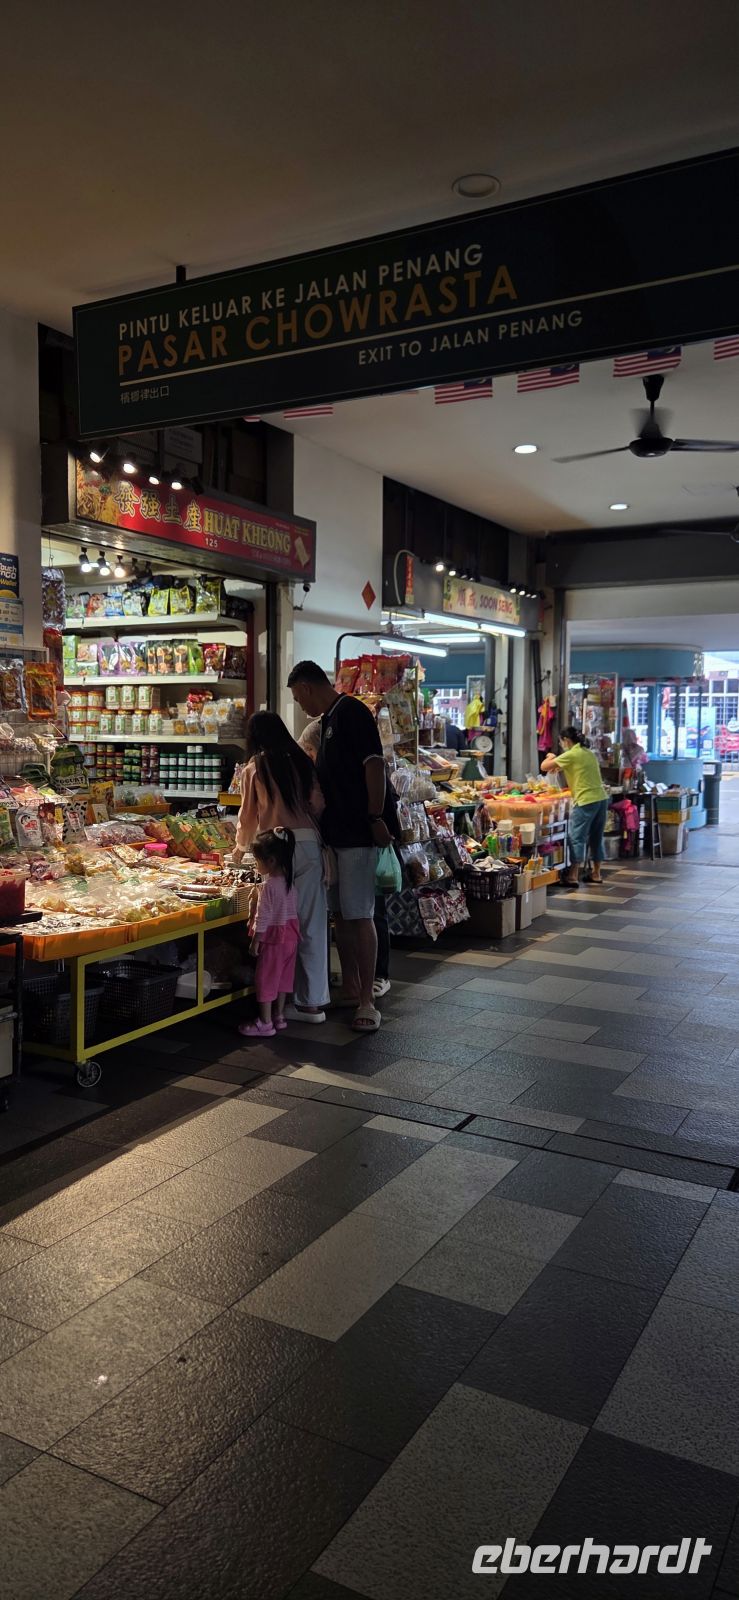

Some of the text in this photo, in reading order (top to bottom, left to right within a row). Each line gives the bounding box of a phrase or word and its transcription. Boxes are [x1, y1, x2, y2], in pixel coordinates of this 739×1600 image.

[118, 243, 483, 341] PINTU KELUAR KE JALAN PENANG
[118, 264, 518, 376] PASAR CHOWRASTA
[358, 310, 584, 365] EXIT TO JALAN PENANG
[203, 508, 291, 553] HUAT KHEONG
[204, 536, 219, 549] 125
[480, 595, 513, 614] SOON SENG
